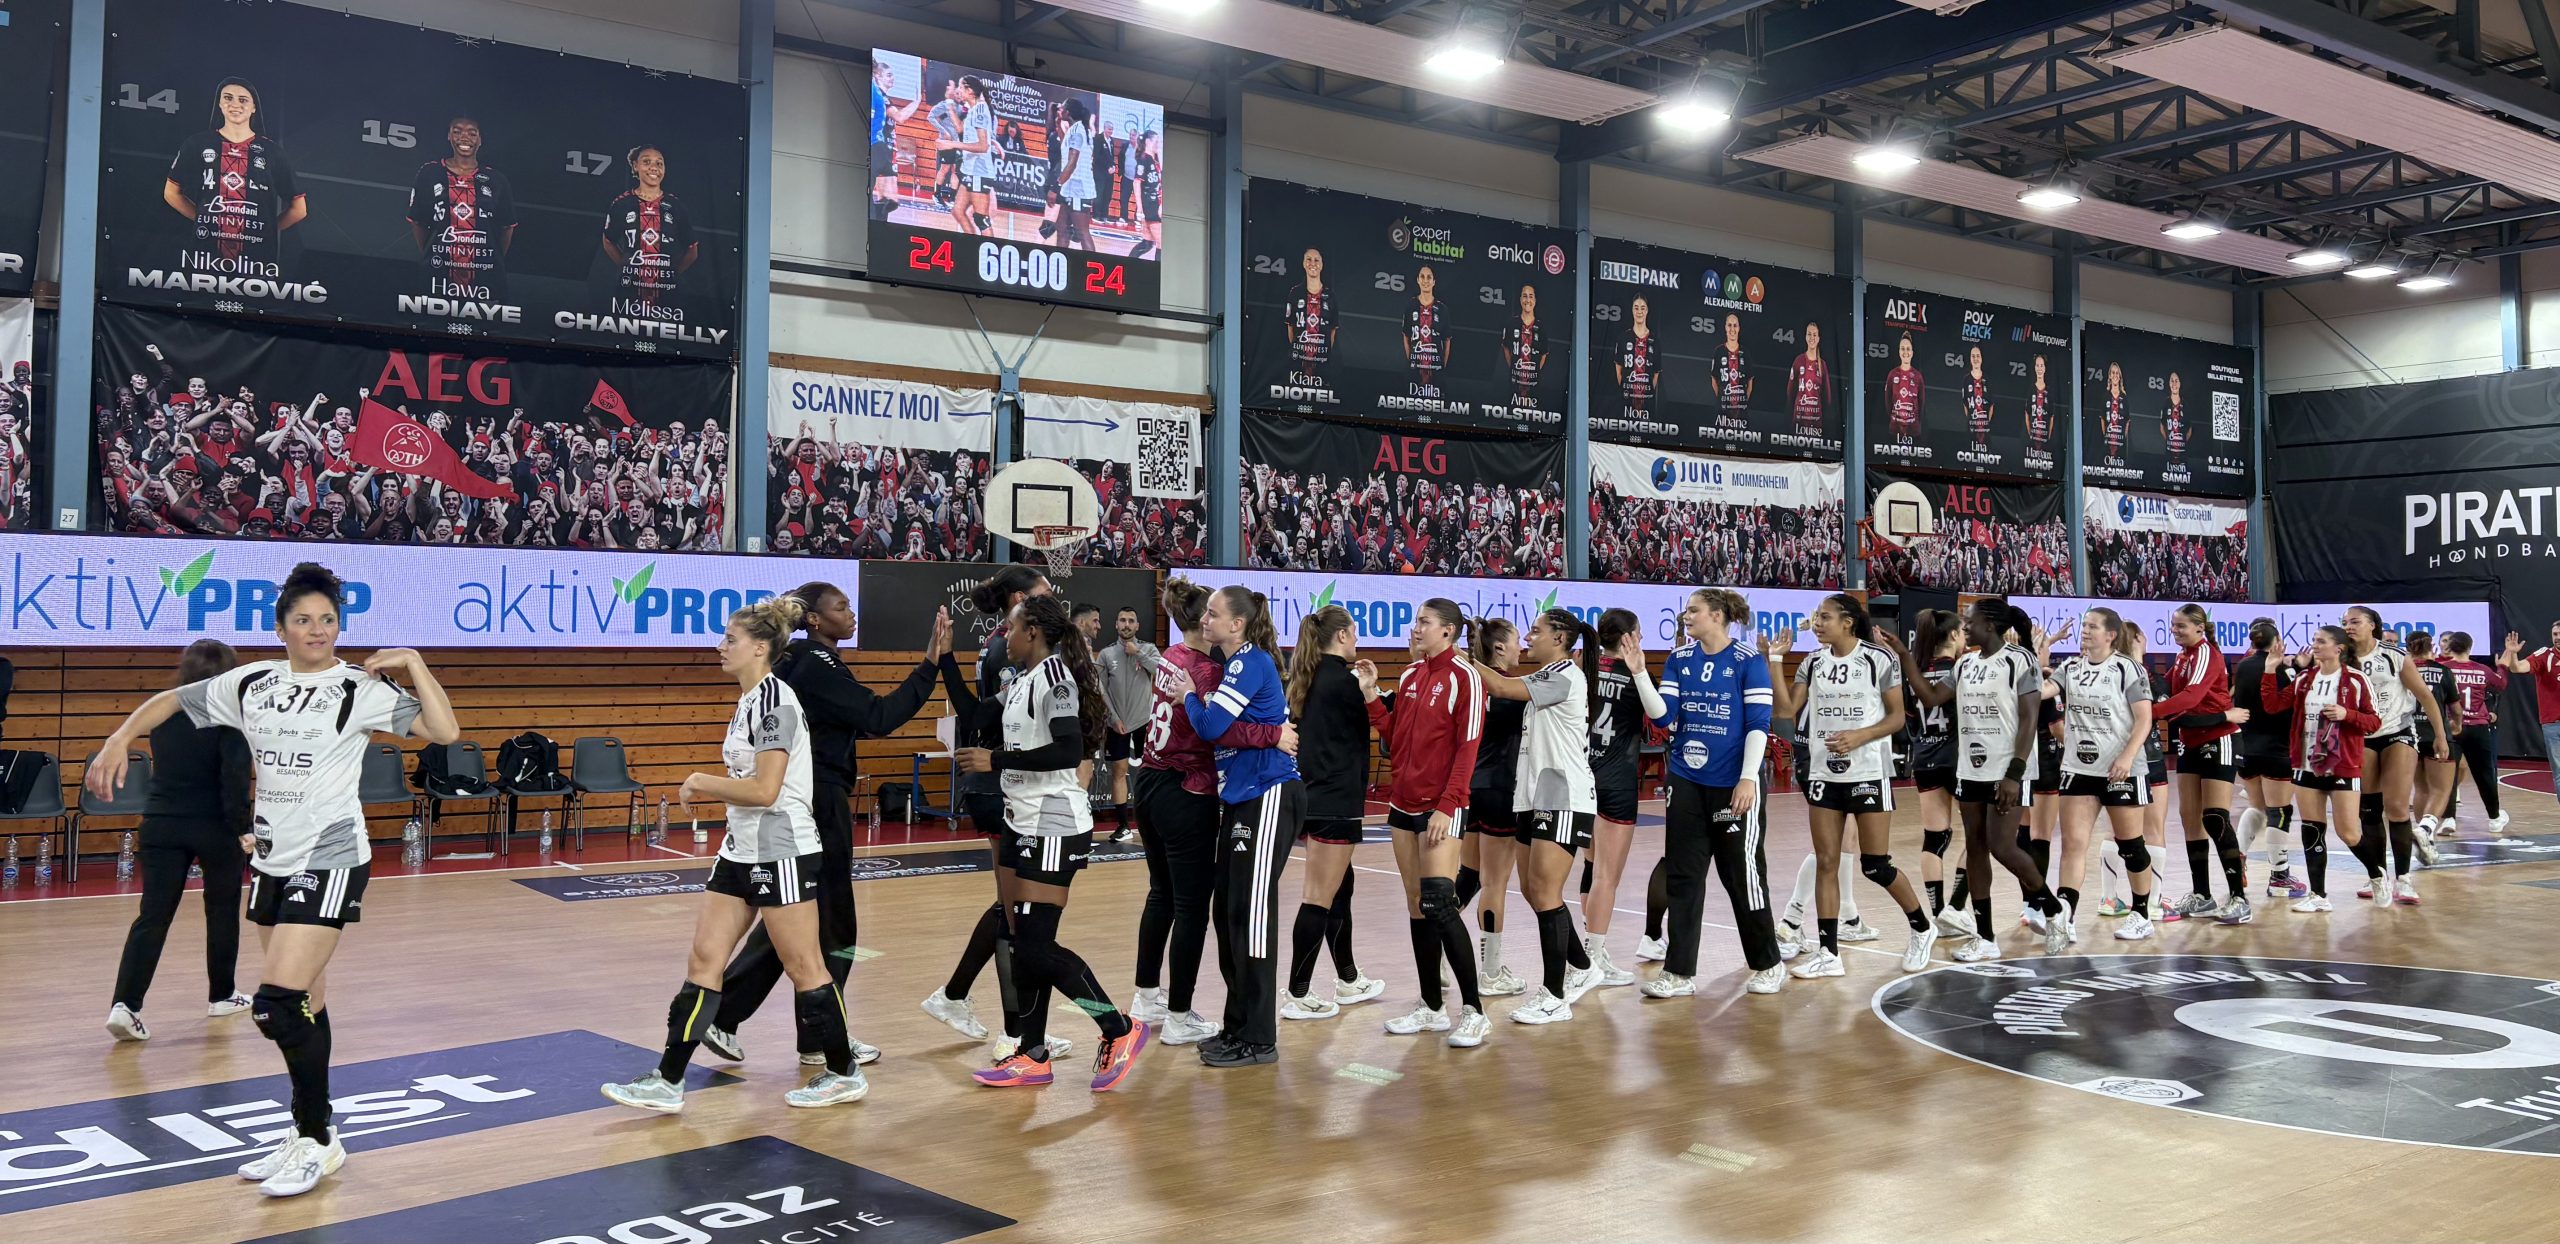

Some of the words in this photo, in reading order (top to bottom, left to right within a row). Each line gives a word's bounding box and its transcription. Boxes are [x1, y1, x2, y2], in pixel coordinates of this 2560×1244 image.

[119, 83, 179, 114] 14
[989, 89, 1046, 111] chersberg
[362, 119, 417, 148] 15
[565, 151, 612, 176] 17
[994, 158, 1046, 187] RATHS
[204, 196, 258, 216] Brondani
[197, 214, 265, 231] EURINVEST
[211, 231, 264, 243] wienerberger
[438, 226, 487, 244] Brondani
[1412, 225, 1451, 241] expert
[432, 244, 494, 257] EURINVEST
[910, 236, 954, 273] 24
[1413, 237, 1465, 259] habitat
[1488, 243, 1534, 265] emka
[181, 249, 279, 277] Nikolina
[444, 261, 494, 270] wienerberger
[978, 241, 1067, 291] 60:00
[1254, 255, 1287, 275] 24
[128, 267, 328, 304] MARKOVIĆ
[1086, 261, 1125, 295] 24
[1375, 271, 1405, 291] 26
[431, 276, 490, 300] Hawa
[1480, 286, 1505, 305] 31
[398, 294, 521, 324] N'DIAYE
[612, 297, 684, 322] Mélissa
[1595, 304, 1621, 322] 33
[1704, 296, 1742, 311] ALEXANDRE
[1744, 300, 1762, 313] PETRI
[1884, 298, 1928, 324] ADEX
[554, 311, 729, 345] CHANTELLY
[1690, 316, 1716, 334] 35
[1964, 310, 1994, 329] POLY
[1772, 328, 1795, 344] 44
[1962, 323, 1992, 340] RACK
[2032, 331, 2068, 348] Manpower
[1868, 342, 1888, 358] 53
[1945, 352, 1964, 368] 64
[2009, 362, 2026, 376] 72
[2211, 364, 2240, 375] BOUTIQUE
[372, 348, 512, 406] AEG
[1289, 371, 1323, 387] Kiara
[2087, 367, 2103, 382] 74
[2148, 376, 2164, 390] 83
[2207, 372, 2243, 384] BILLETTERIE
[1270, 384, 1340, 404] DIOTEL
[1409, 382, 1440, 397] Dalila
[792, 382, 893, 419] SCANNEZ
[899, 393, 939, 422] MOI
[1377, 394, 1469, 415] ABDESSELAM
[1511, 393, 1537, 408] Anne
[1481, 404, 1561, 424] TOLSTRUP
[1624, 405, 1649, 420] Nora
[1715, 414, 1747, 428] Albane
[1588, 416, 1680, 436] SNEDKERUD
[1698, 426, 1761, 443] FRACHON
[1795, 423, 1822, 436] Louise
[1771, 433, 1842, 451] DENOYELLE
[1874, 444, 1932, 459] FARGUES
[1971, 441, 1987, 453] Lina
[1373, 434, 1447, 475] AEG
[1957, 451, 2001, 465] COLINOT
[2104, 455, 2124, 467] Olivia
[1680, 461, 1722, 485] JUNG
[2024, 458, 2054, 471] IMHOF
[2082, 465, 2144, 480] ROUGE-CARRASSAT
[1731, 472, 1788, 490] MOMMENHEIM
[1944, 484, 1991, 515] AEG
[61, 512, 76, 524] 27
[2405, 486, 2560, 555] PIRAT
[1700, 661, 1715, 682] 8
[1827, 664, 1848, 684] 43
[1969, 665, 1988, 684] 24
[2079, 671, 2100, 687] 27
[250, 675, 280, 695] Hertz
[2317, 680, 2331, 696] 11
[276, 685, 318, 714] 31
[276, 768, 310, 777] BESANÇON
[535, 1185, 841, 1244] gaz
[759, 1211, 895, 1244] CITÉ
